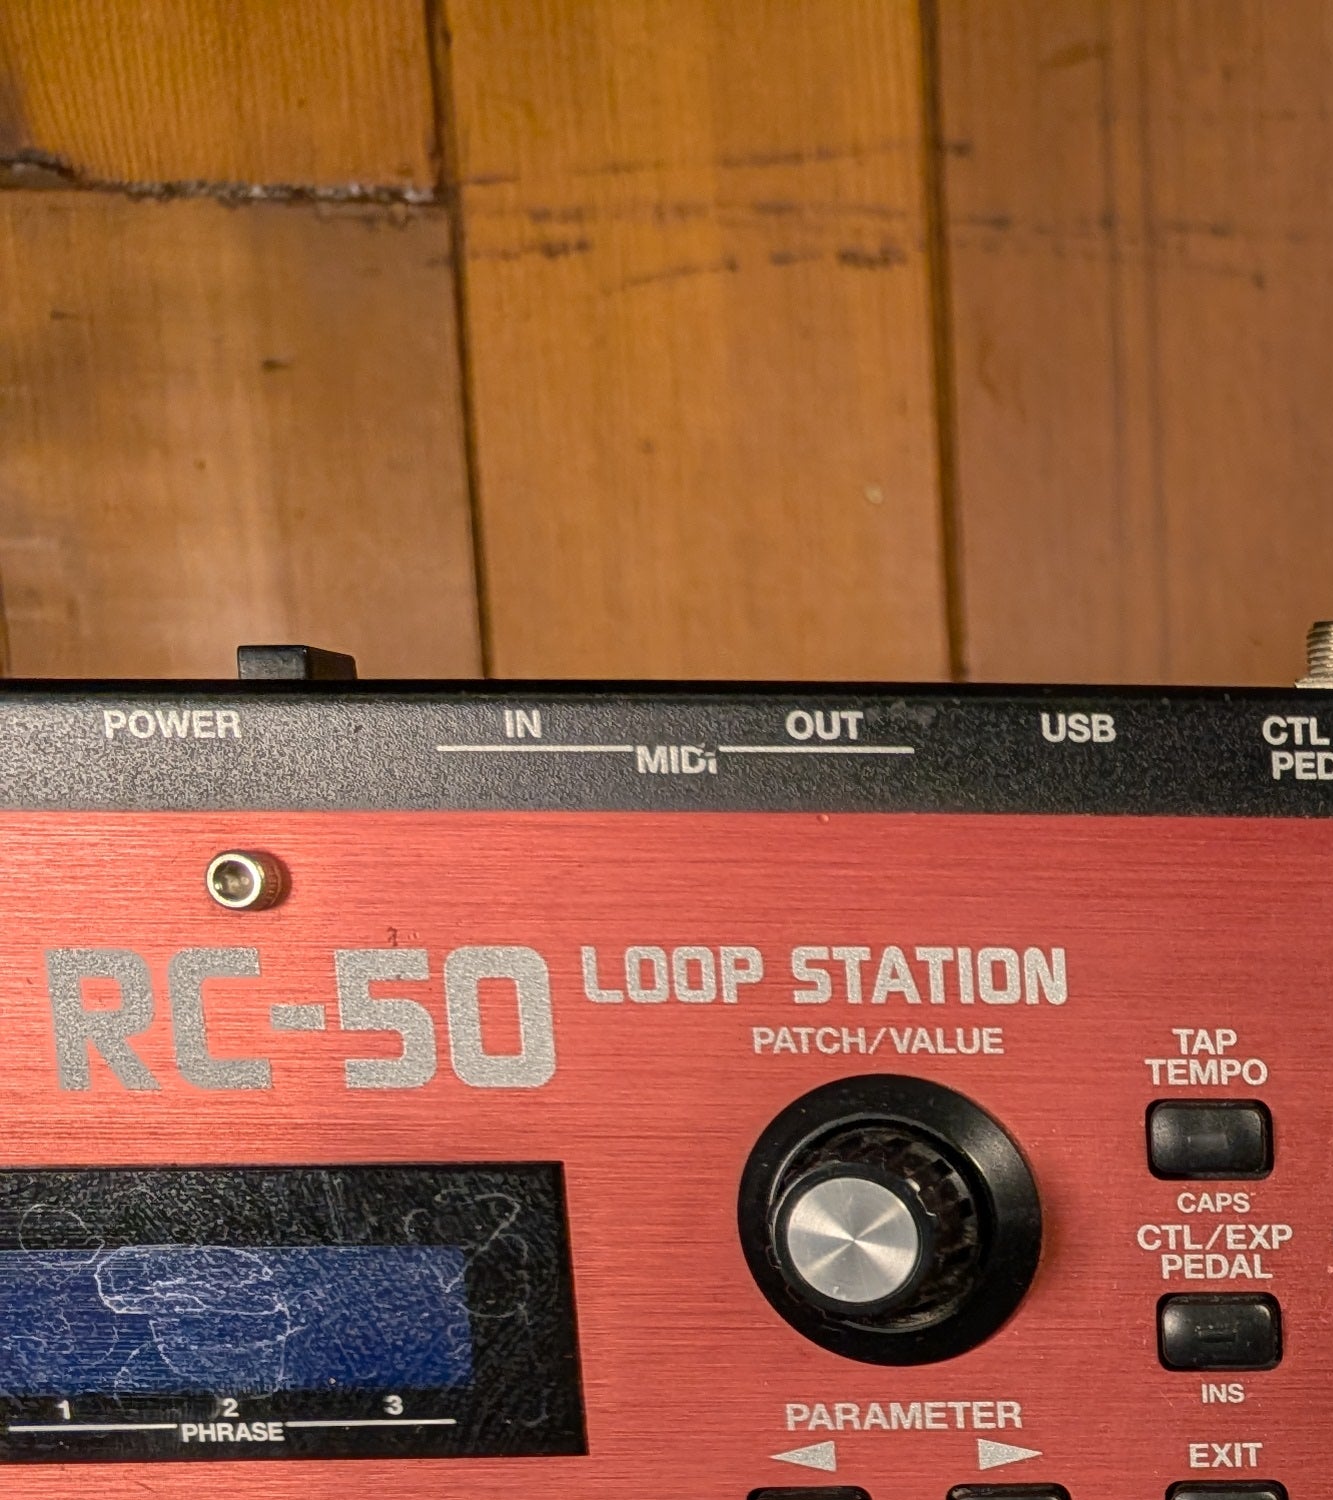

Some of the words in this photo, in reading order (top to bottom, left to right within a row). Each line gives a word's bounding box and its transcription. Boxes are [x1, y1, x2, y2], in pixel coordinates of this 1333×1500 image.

[103, 710, 242, 740] POWER
[505, 711, 542, 739] IN
[785, 712, 863, 740] OUT
[1041, 714, 1116, 743] USB
[1262, 718, 1330, 746] CTL
[636, 743, 717, 774] MIDI
[580, 946, 764, 1003] LOOP
[792, 947, 1068, 1005] STATION
[45, 946, 556, 1091] RC-50
[753, 1028, 1004, 1055] PATCH/VALUE
[1172, 1029, 1238, 1055] TAP
[1145, 1059, 1268, 1087] TEMPO
[1177, 1192, 1250, 1214] CAPS
[1137, 1225, 1293, 1251] CTL/EXP
[1162, 1254, 1272, 1279] PEDAL
[384, 1396, 404, 1415] 3
[1201, 1383, 1245, 1405] INS
[56, 1400, 71, 1420] 1
[222, 1399, 239, 1418] 2
[785, 1402, 1022, 1431] PARAMETER
[181, 1421, 284, 1443] PHRASE
[1189, 1444, 1262, 1468] EXIT
